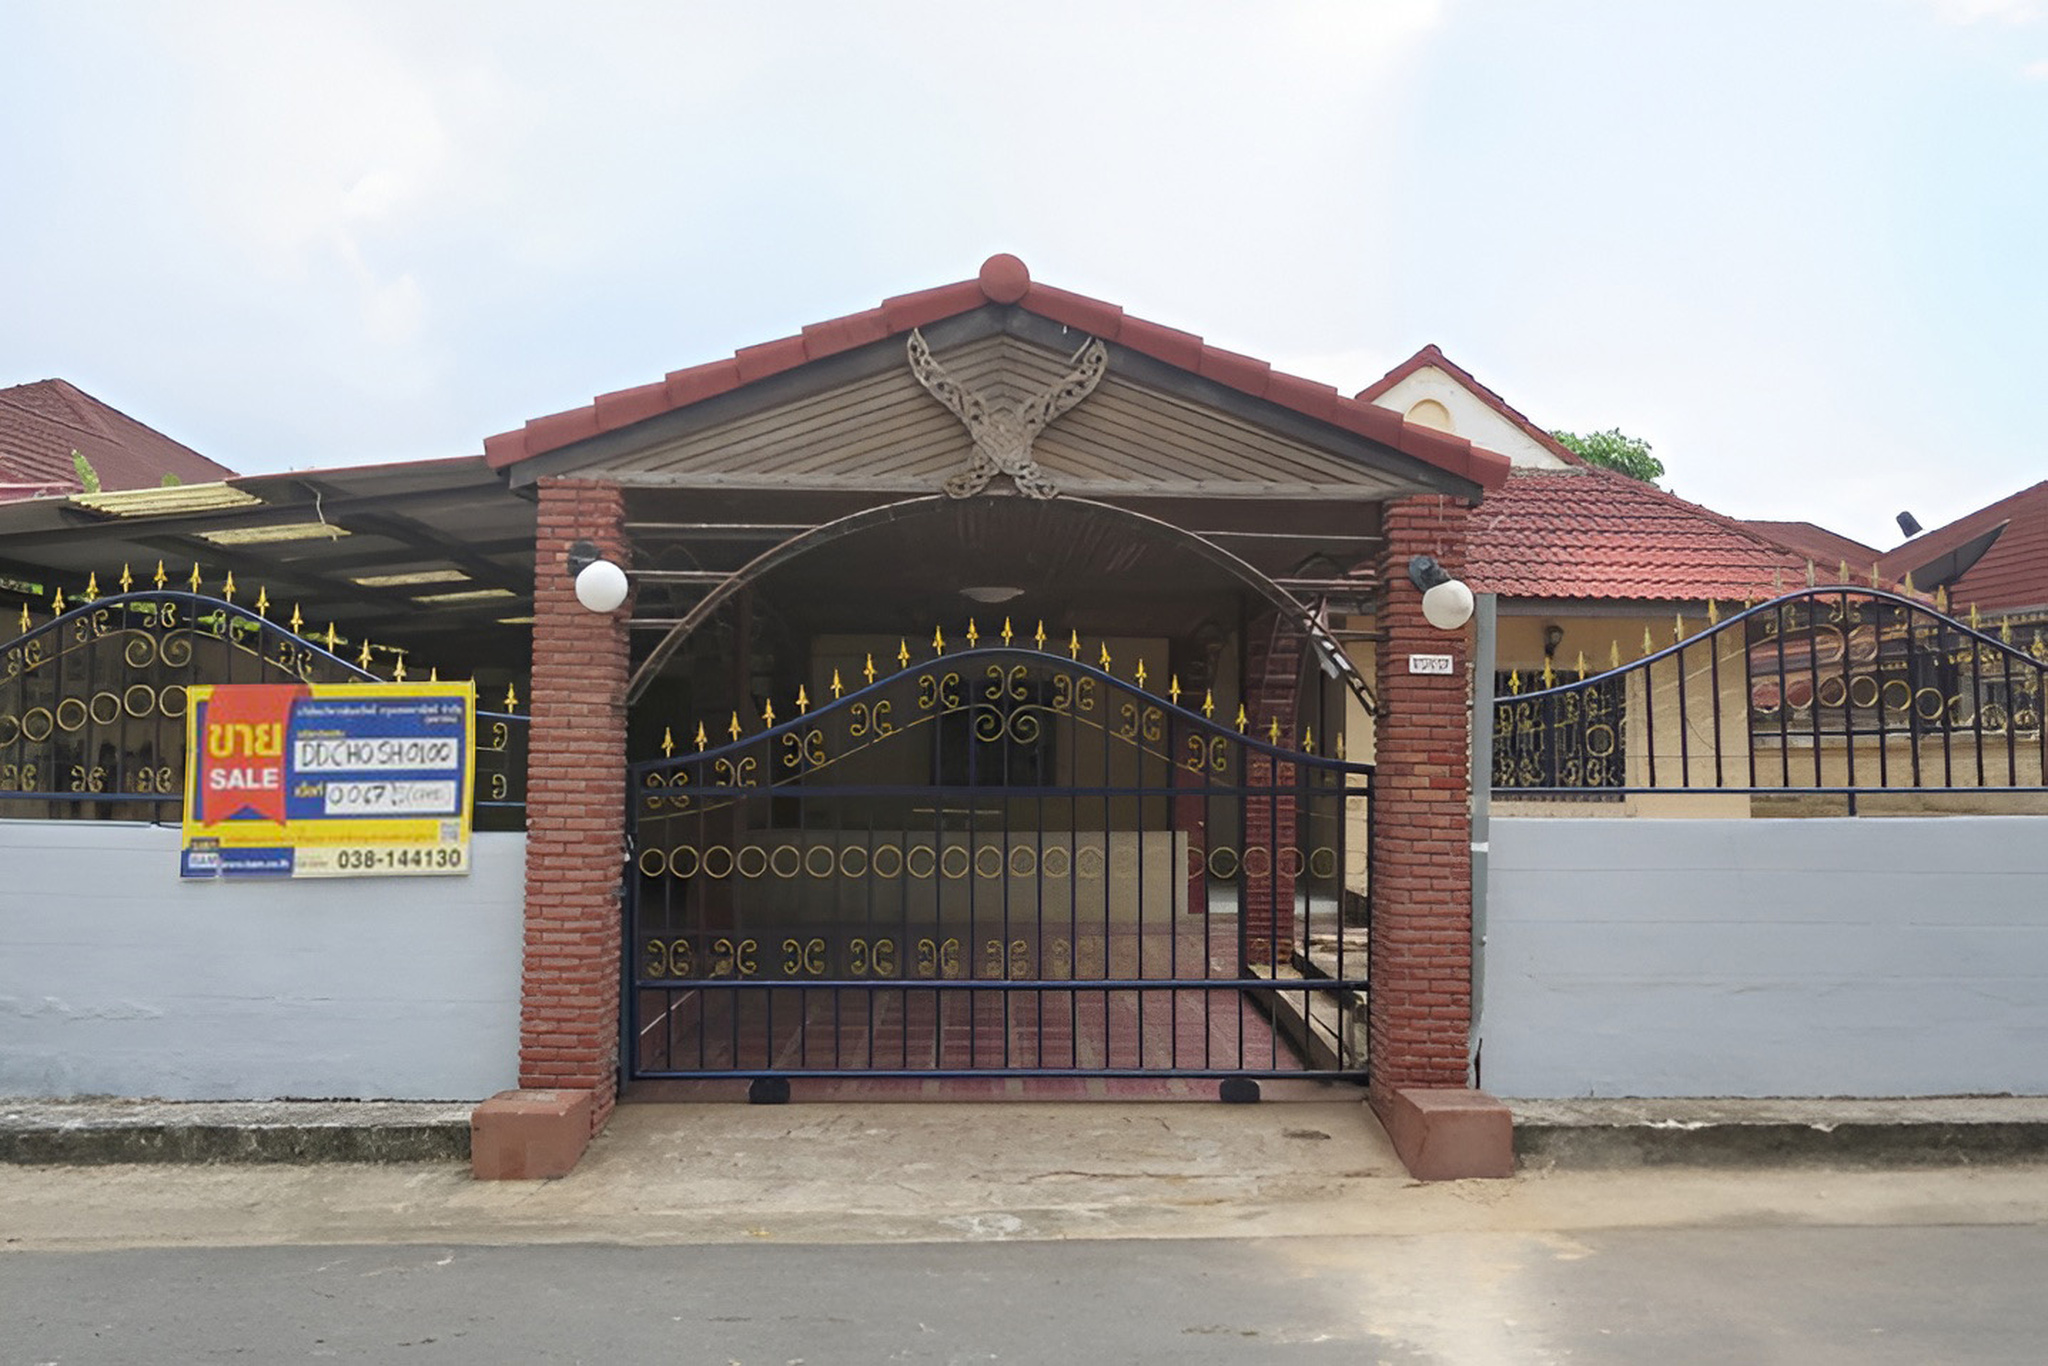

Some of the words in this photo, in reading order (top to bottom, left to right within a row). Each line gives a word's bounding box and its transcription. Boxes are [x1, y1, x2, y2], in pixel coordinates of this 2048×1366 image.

[208, 721, 283, 758] ขาย
[209, 767, 280, 790] SALE
[337, 848, 462, 869] 038-144130
